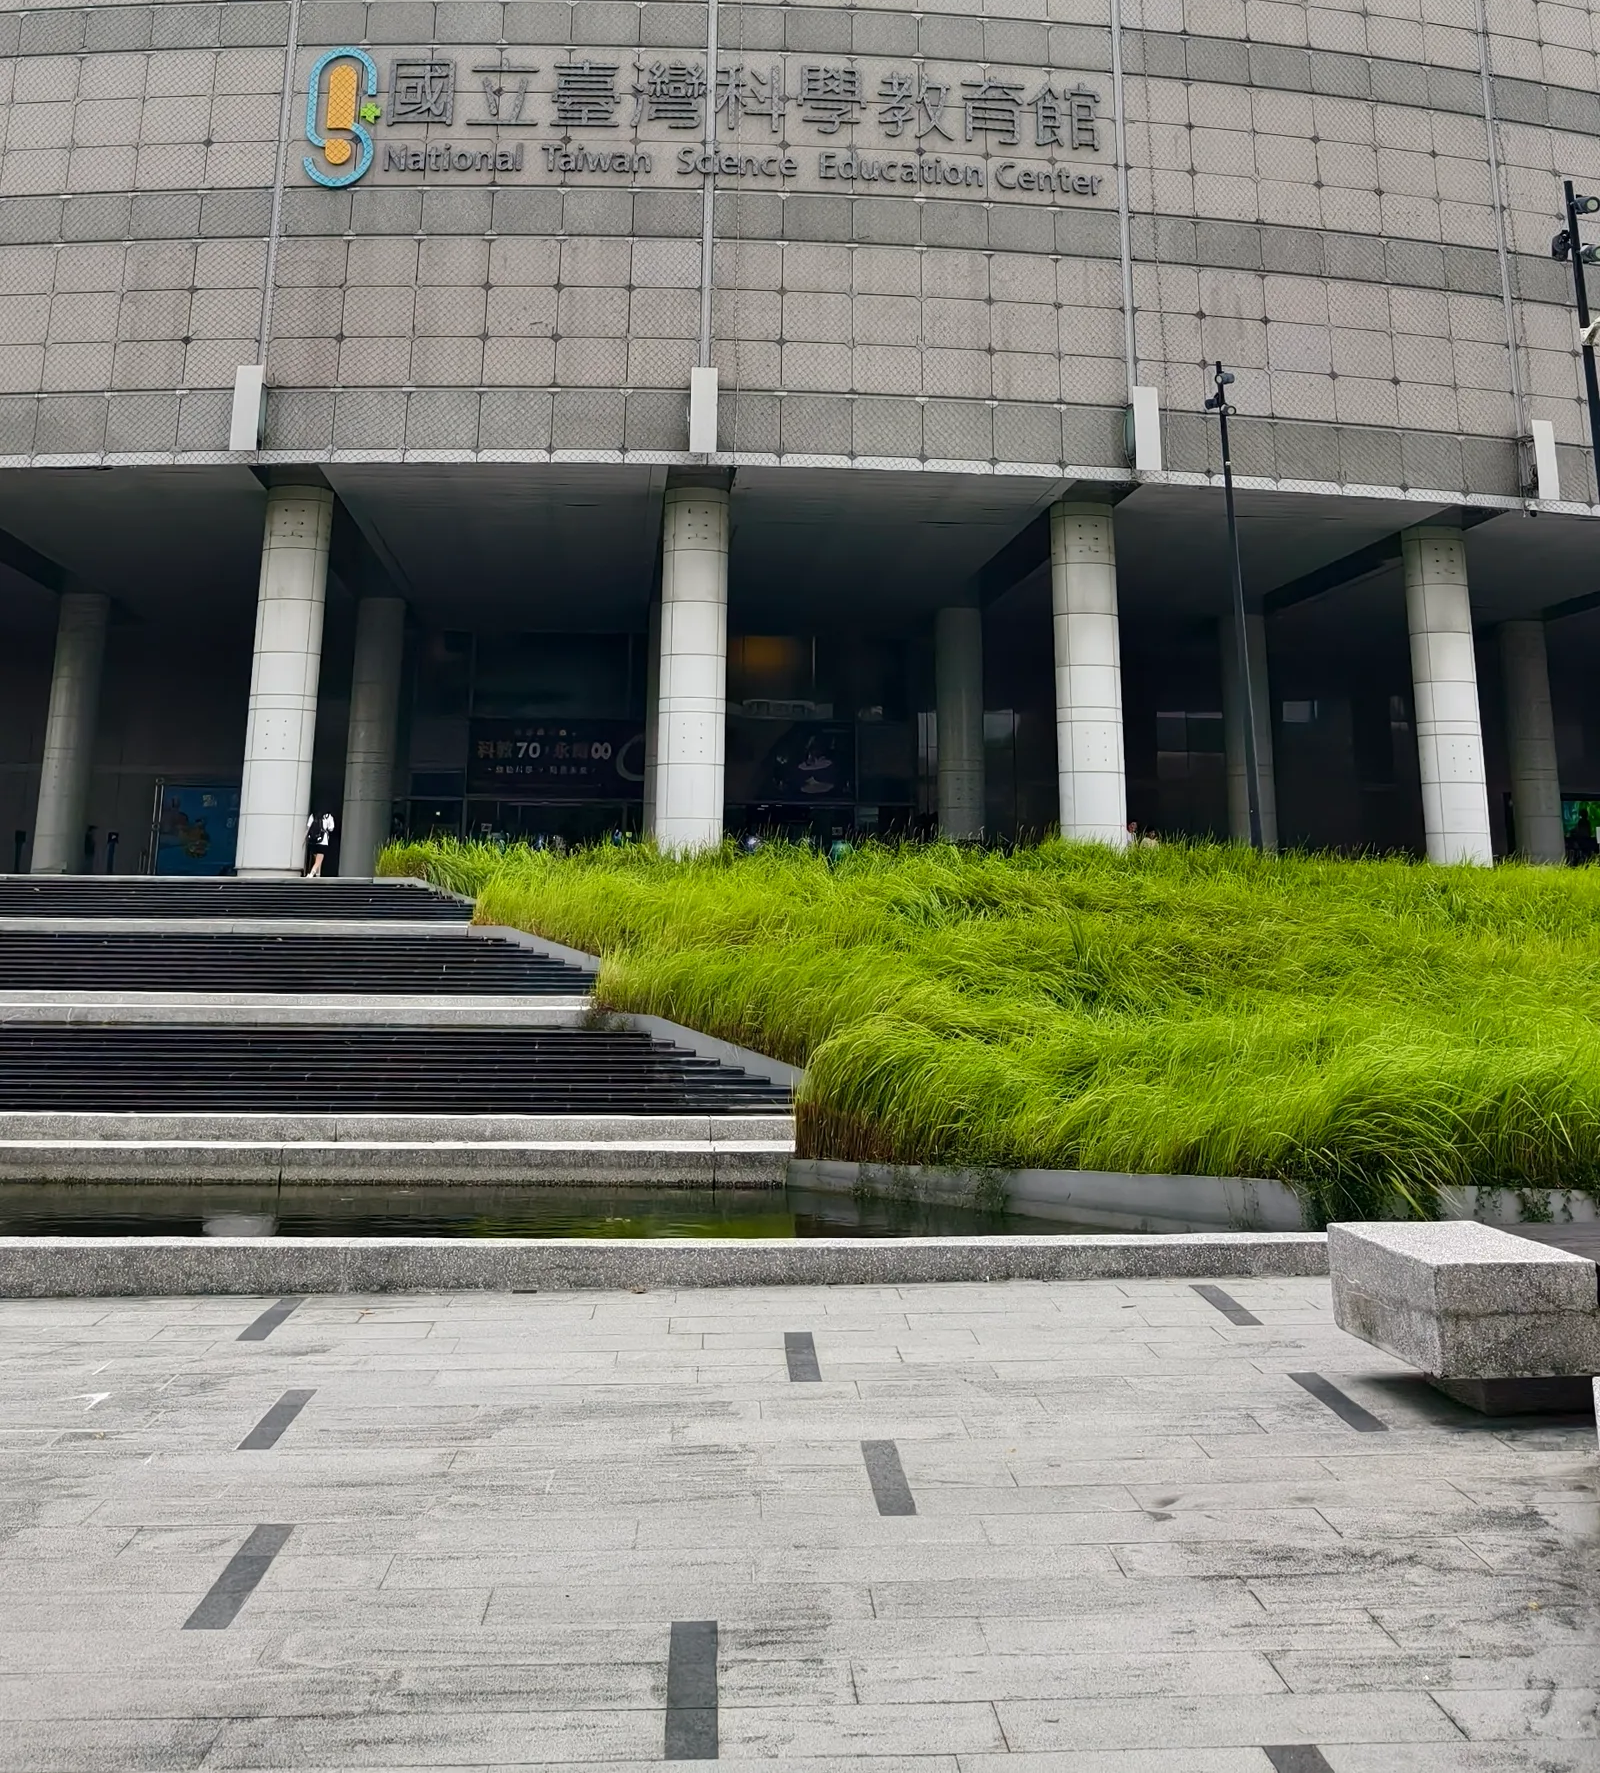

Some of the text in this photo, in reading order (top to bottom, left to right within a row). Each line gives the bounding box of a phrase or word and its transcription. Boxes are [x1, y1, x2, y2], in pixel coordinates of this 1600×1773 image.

[386, 58, 1101, 151] 國立臺灣科學教育館
[384, 144, 1104, 197] National Taiwan Science Education Center
